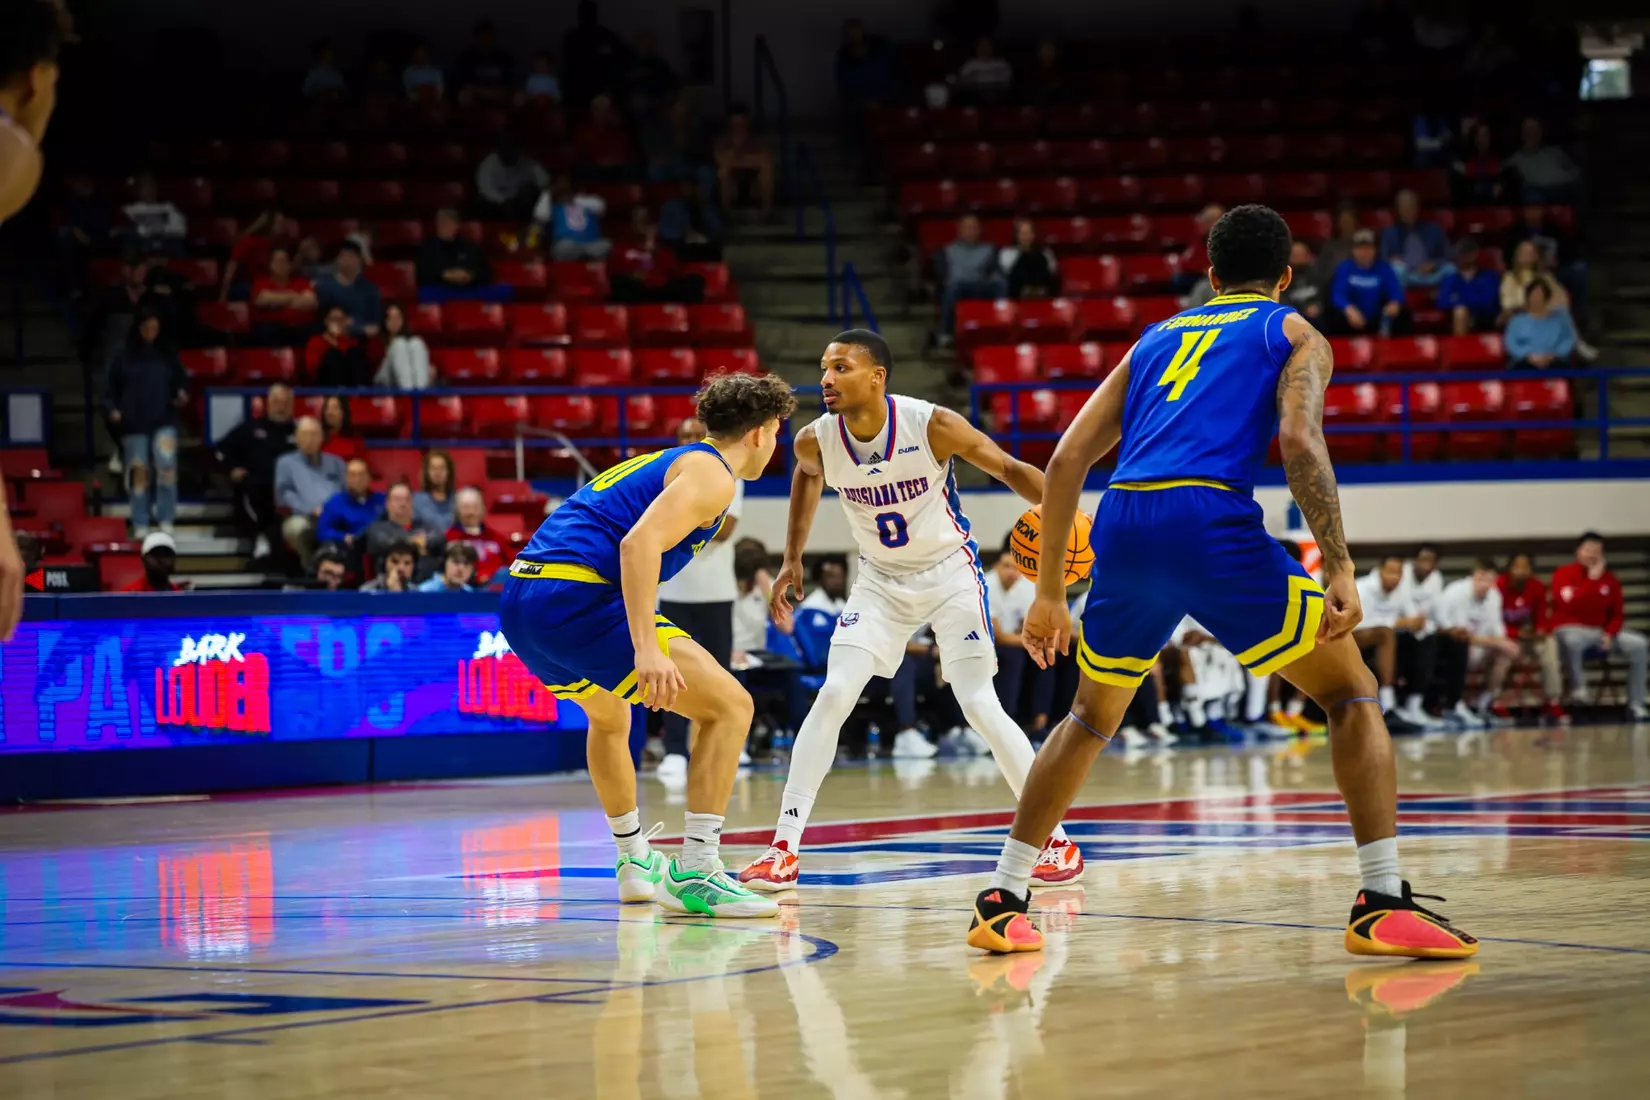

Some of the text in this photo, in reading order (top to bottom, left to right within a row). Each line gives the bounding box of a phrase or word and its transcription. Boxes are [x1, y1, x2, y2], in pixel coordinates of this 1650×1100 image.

[1156, 327, 1223, 402] 4
[897, 476, 930, 503] TECH
[875, 511, 910, 549] 0
[174, 632, 246, 667] BARK
[155, 652, 272, 733] LOUDER
